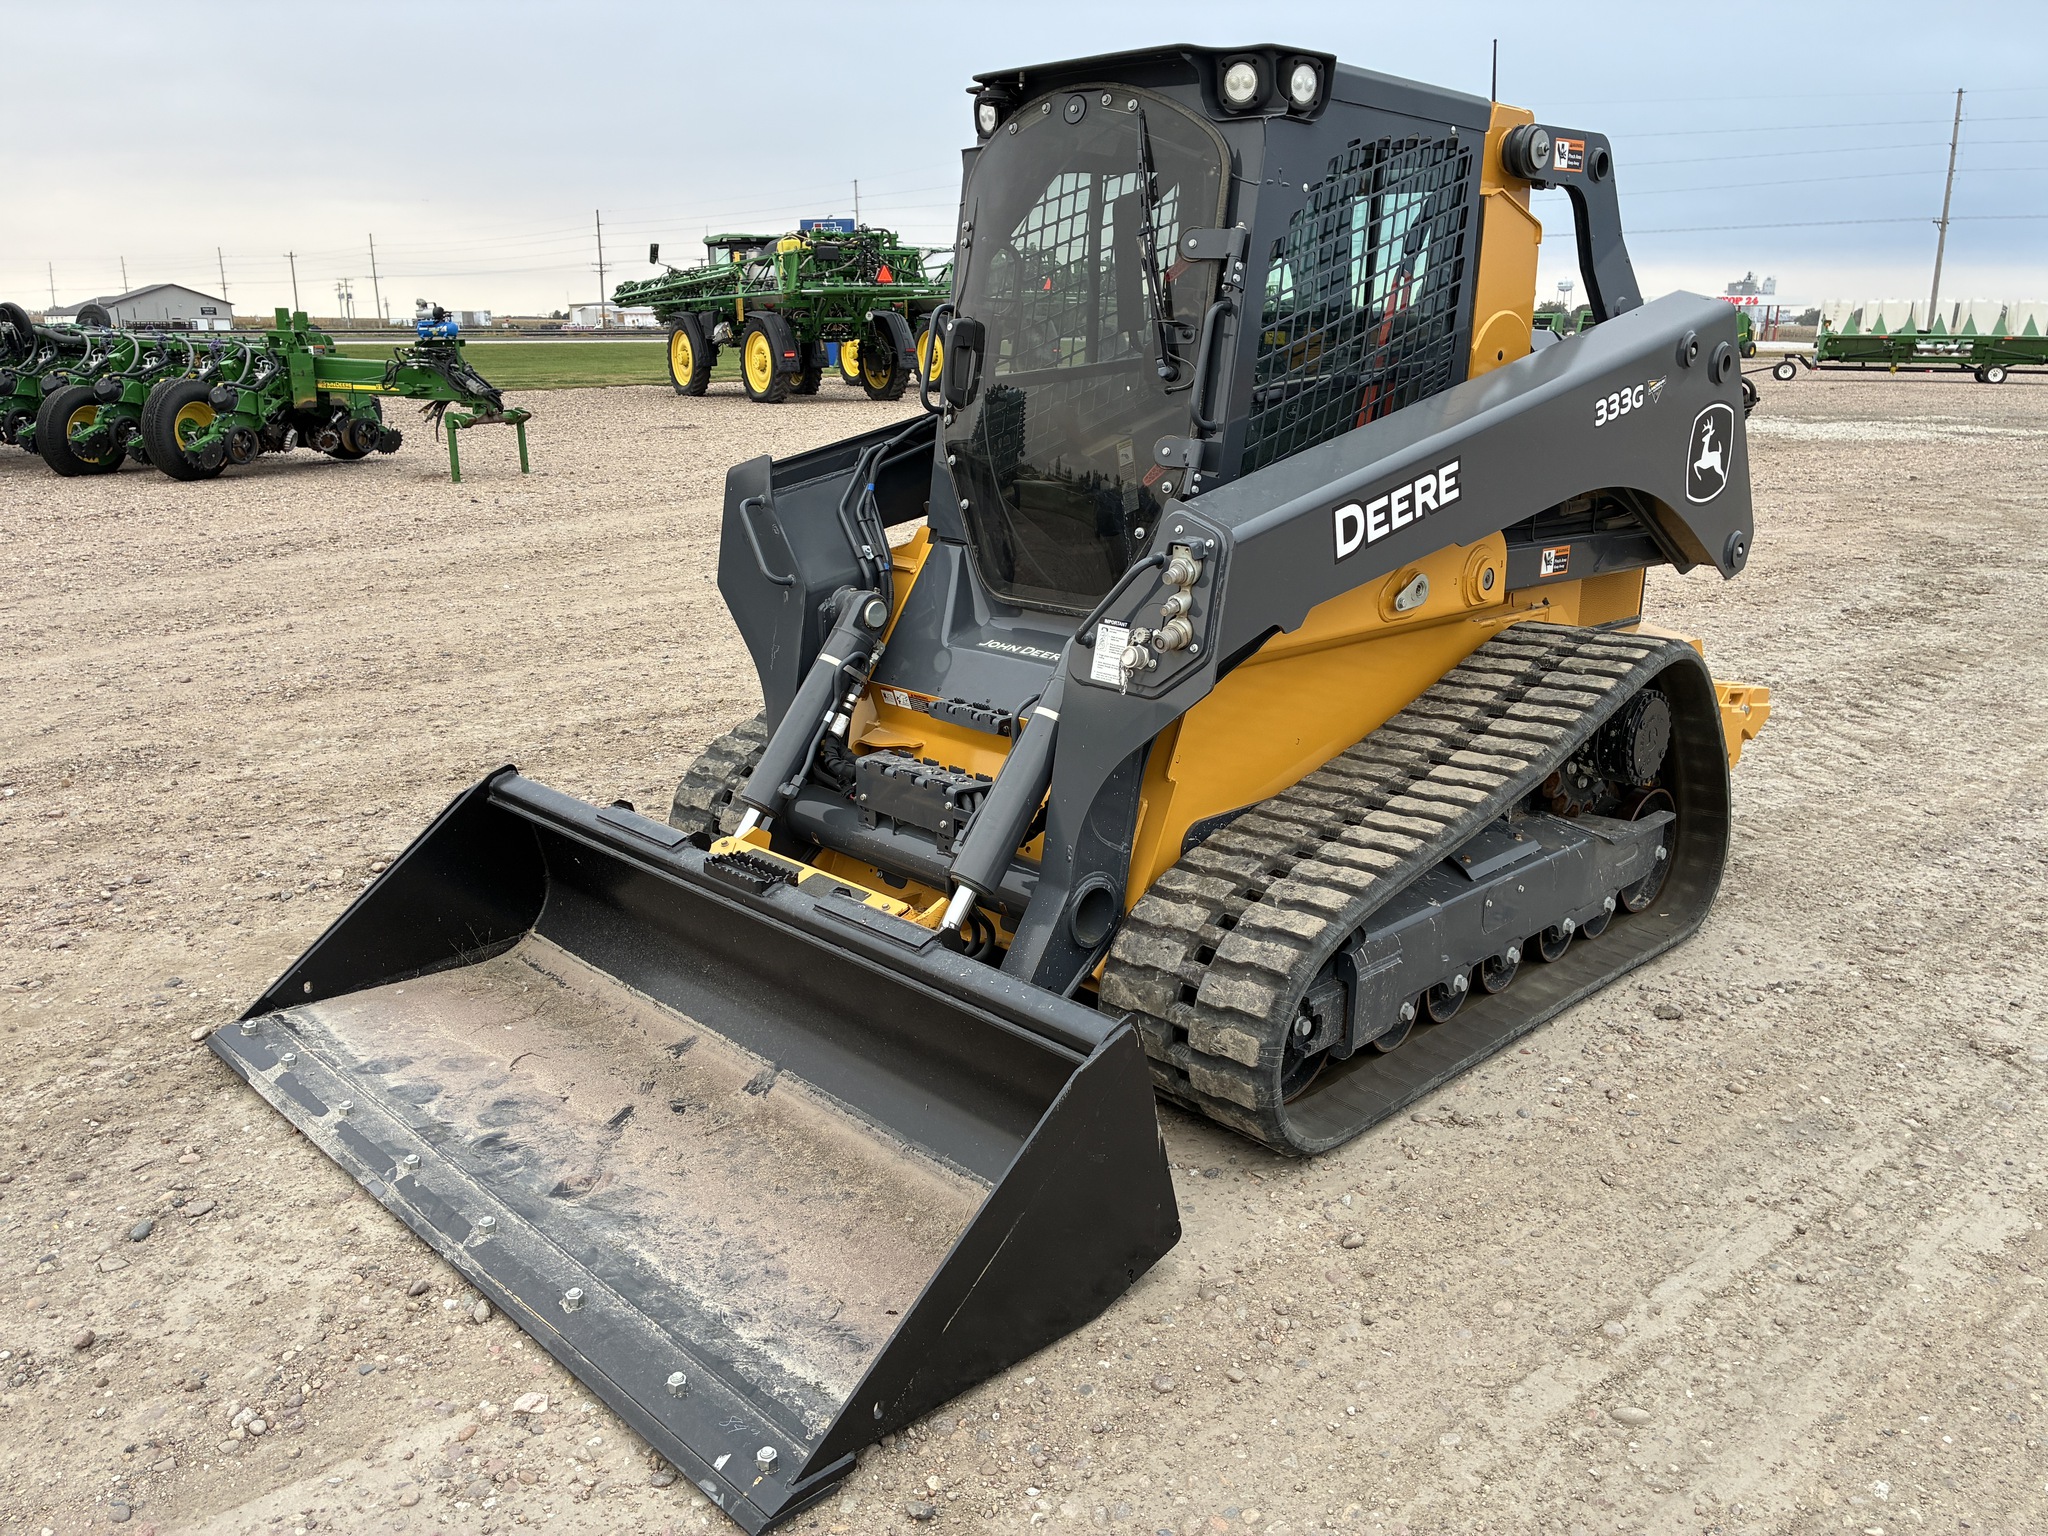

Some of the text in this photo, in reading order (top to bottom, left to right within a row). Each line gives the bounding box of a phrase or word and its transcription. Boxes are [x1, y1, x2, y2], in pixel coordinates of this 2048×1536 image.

[1717, 296, 1743, 305] TOP
[1595, 384, 1644, 427] 333G
[1334, 460, 1460, 559] DEERE
[1104, 618, 1128, 628] IMPORTANT
[978, 639, 1062, 661] JOHN DEER
